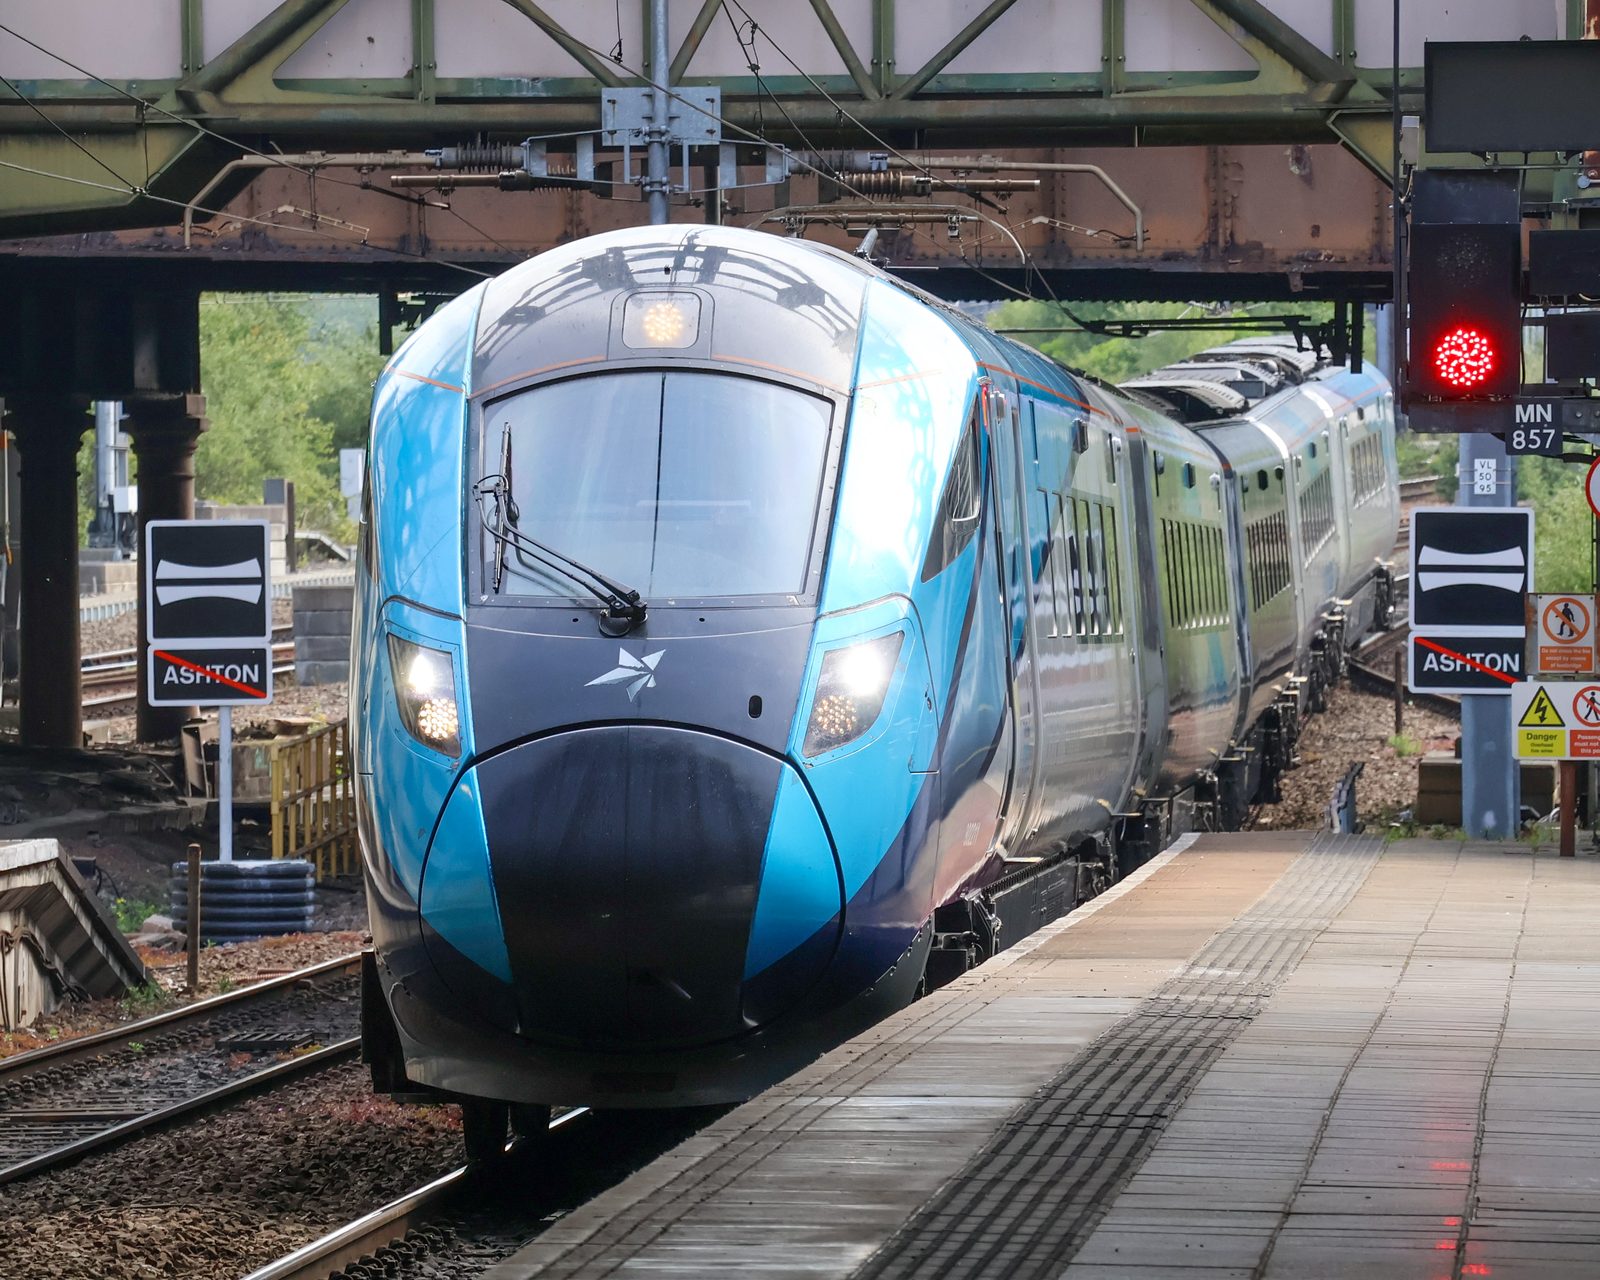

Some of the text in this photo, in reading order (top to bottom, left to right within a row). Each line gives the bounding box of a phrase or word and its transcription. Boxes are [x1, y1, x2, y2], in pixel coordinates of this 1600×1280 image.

[1515, 403, 1552, 423] MN
[1512, 429, 1556, 450] 857
[1480, 460, 1492, 469] VL
[1479, 472, 1491, 481] 50
[1479, 484, 1491, 493] 95
[1423, 652, 1520, 672] ASHTON
[163, 664, 259, 685] ASHTON
[1526, 732, 1558, 742] Danger
